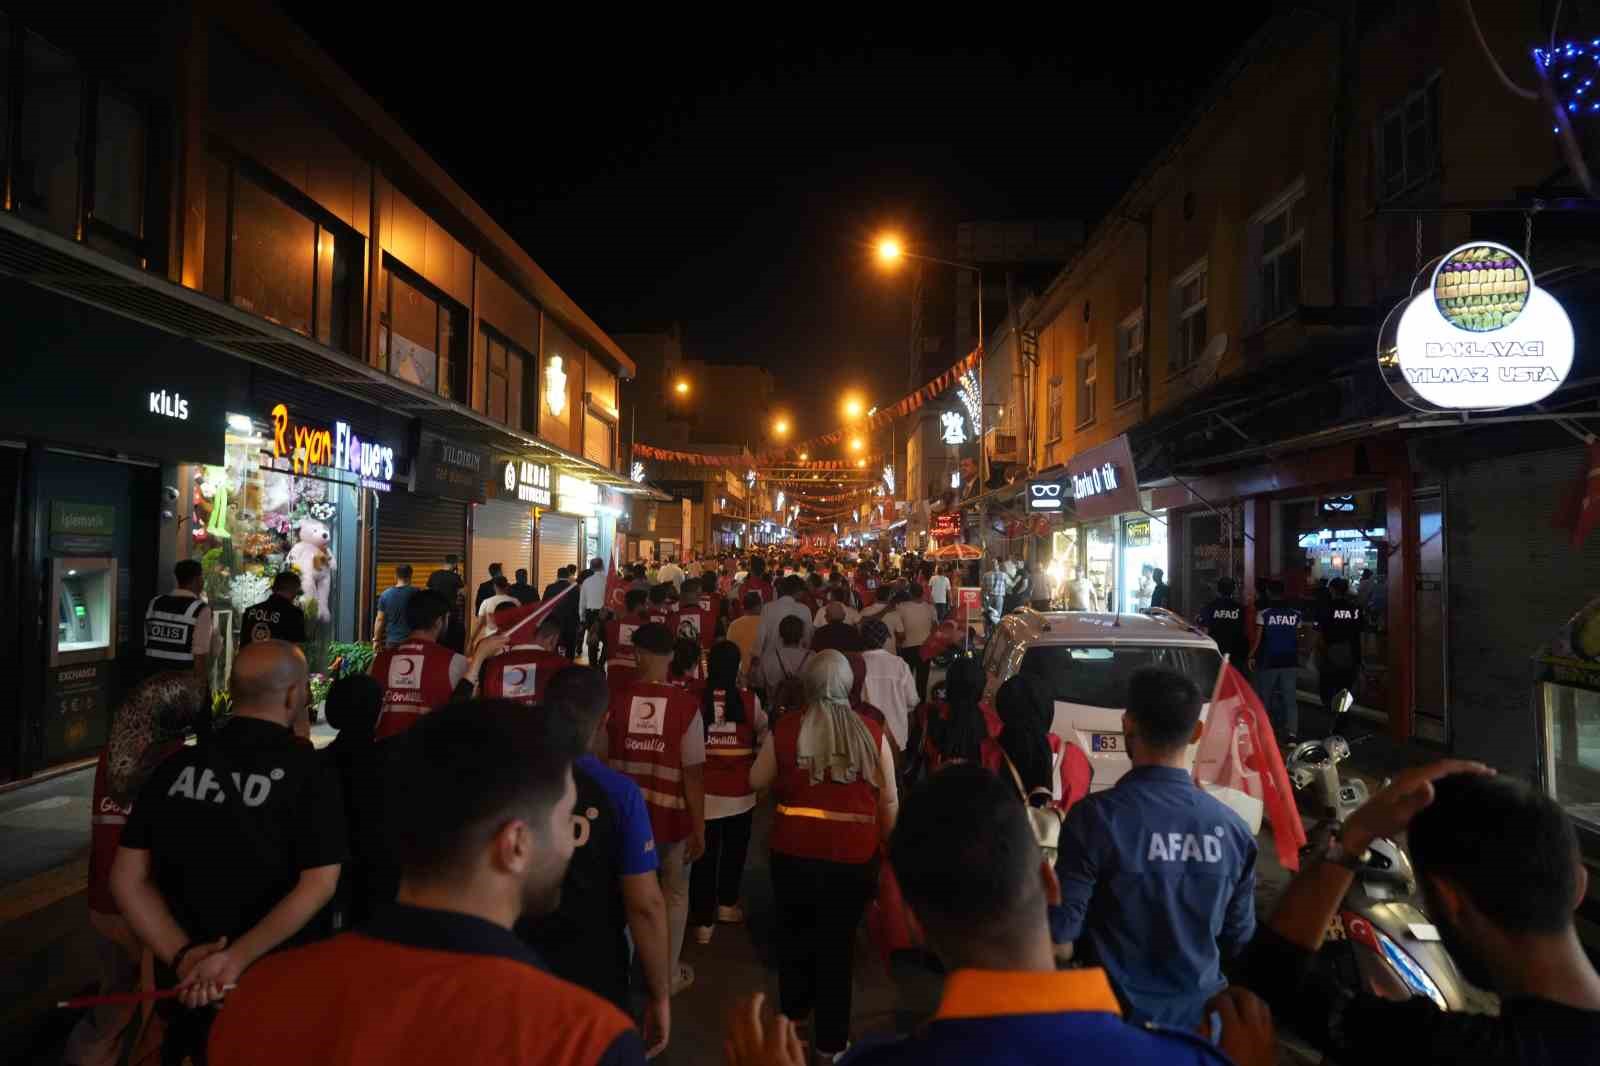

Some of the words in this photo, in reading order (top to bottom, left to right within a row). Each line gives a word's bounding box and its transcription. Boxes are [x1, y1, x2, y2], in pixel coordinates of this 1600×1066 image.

[1406, 367, 1489, 383] YILMAZ
[1498, 366, 1560, 382] USTA
[1268, 614, 1298, 625] AFAD
[1100, 736, 1117, 750] 63
[1147, 832, 1222, 863] AFAD
